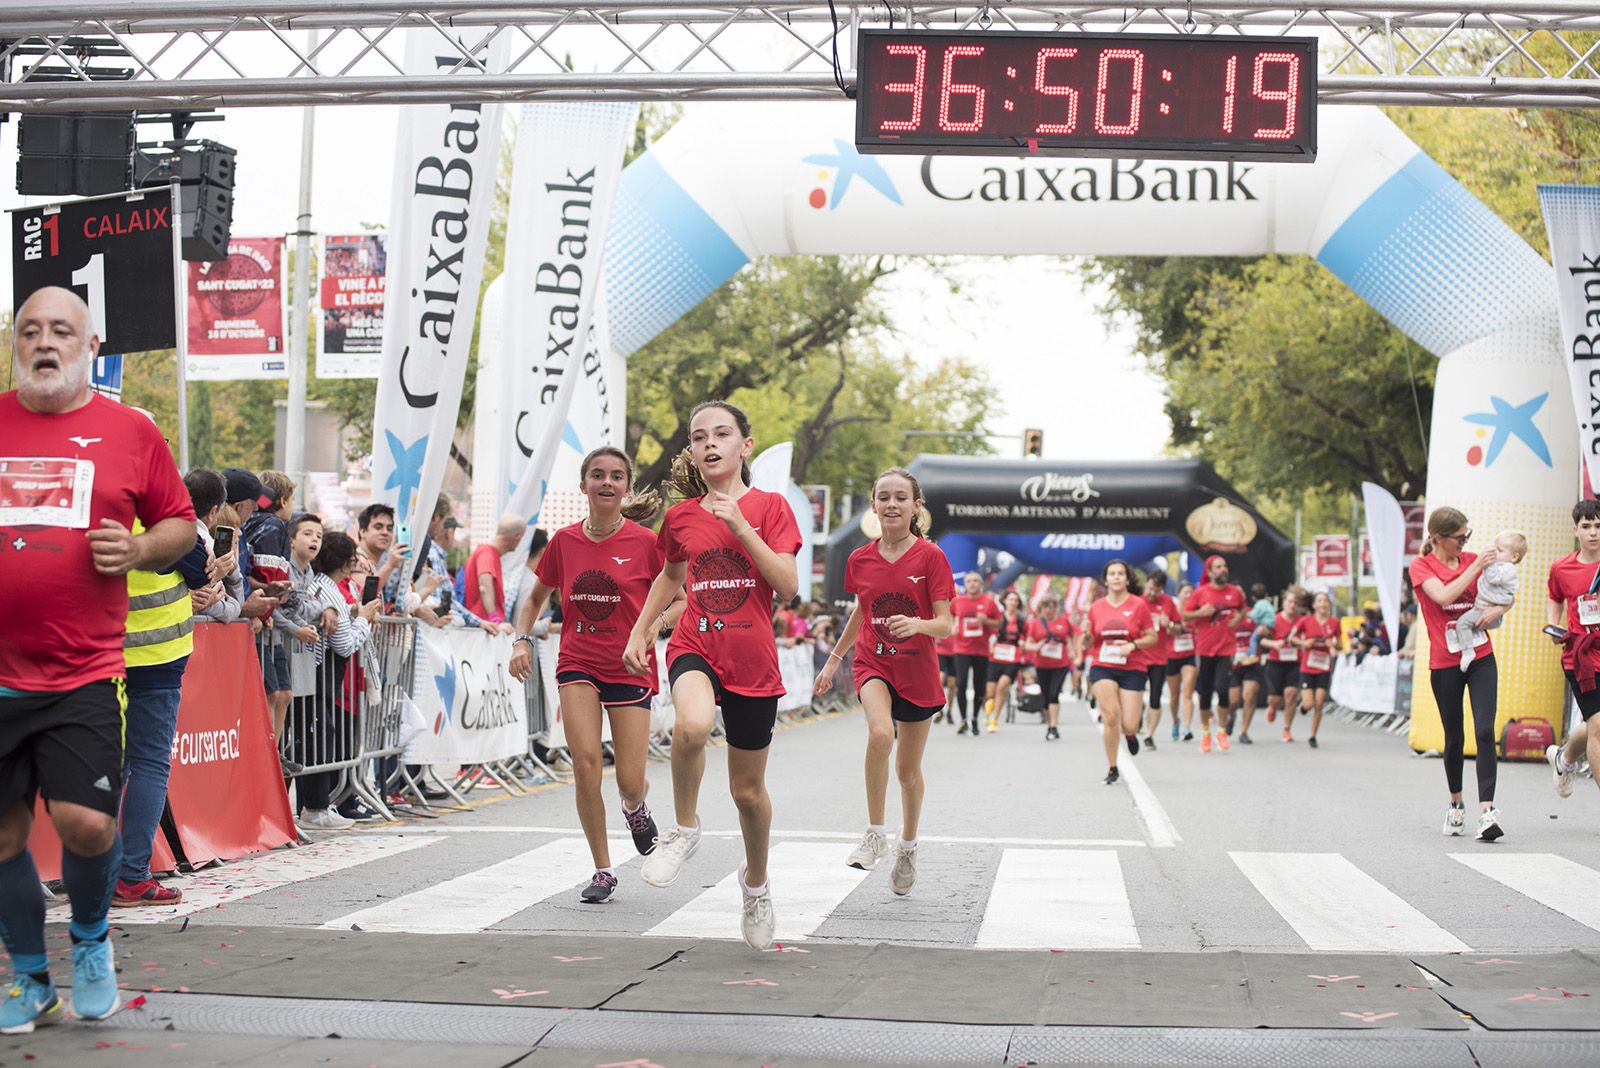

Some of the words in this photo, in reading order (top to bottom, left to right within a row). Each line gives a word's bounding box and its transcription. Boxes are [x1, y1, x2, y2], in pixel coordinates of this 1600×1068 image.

[919, 156, 1260, 203] CaixaBank
[83, 206, 169, 239] CALAIX
[399, 33, 489, 409] CaixaBak
[337, 278, 366, 291] VINE
[367, 278, 377, 289] A
[71, 253, 107, 343] 1
[334, 293, 350, 306] EL
[946, 503, 1009, 518] TORRONS
[1011, 504, 1077, 518] ARTESANS
[722, 547, 734, 557] DE
[691, 580, 709, 592] SANT
[710, 579, 741, 589] CUGAT
[569, 593, 587, 601] SANT
[587, 594, 610, 602] CUGAT
